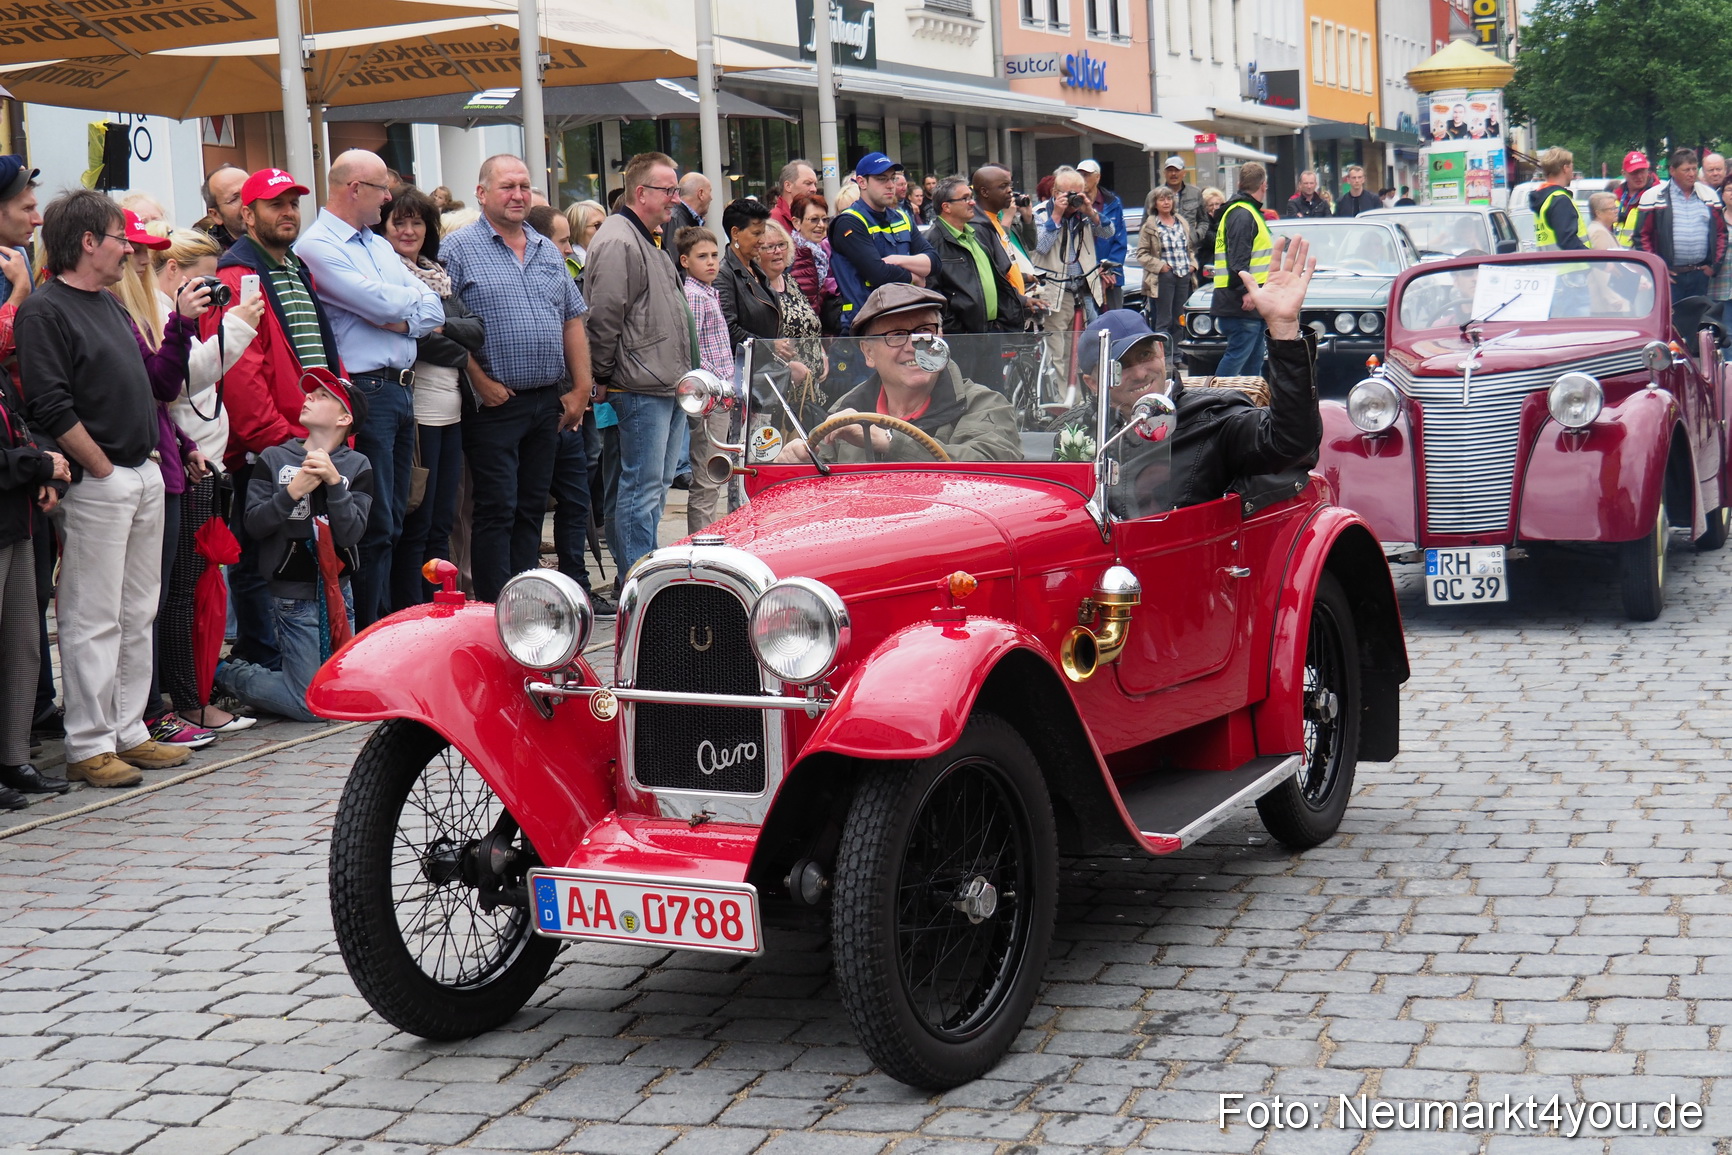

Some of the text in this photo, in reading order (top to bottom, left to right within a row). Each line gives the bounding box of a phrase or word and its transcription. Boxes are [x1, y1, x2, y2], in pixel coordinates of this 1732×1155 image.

[1473, 0, 1496, 56] OT
[267, 175, 294, 186] DEKRA
[1513, 278, 1540, 291] 370
[1428, 565, 1435, 573] D
[1440, 552, 1471, 576] RH
[1432, 576, 1501, 601] QC 39
[544, 909, 554, 921] D
[567, 886, 617, 930] AA
[642, 892, 744, 942] 0788
